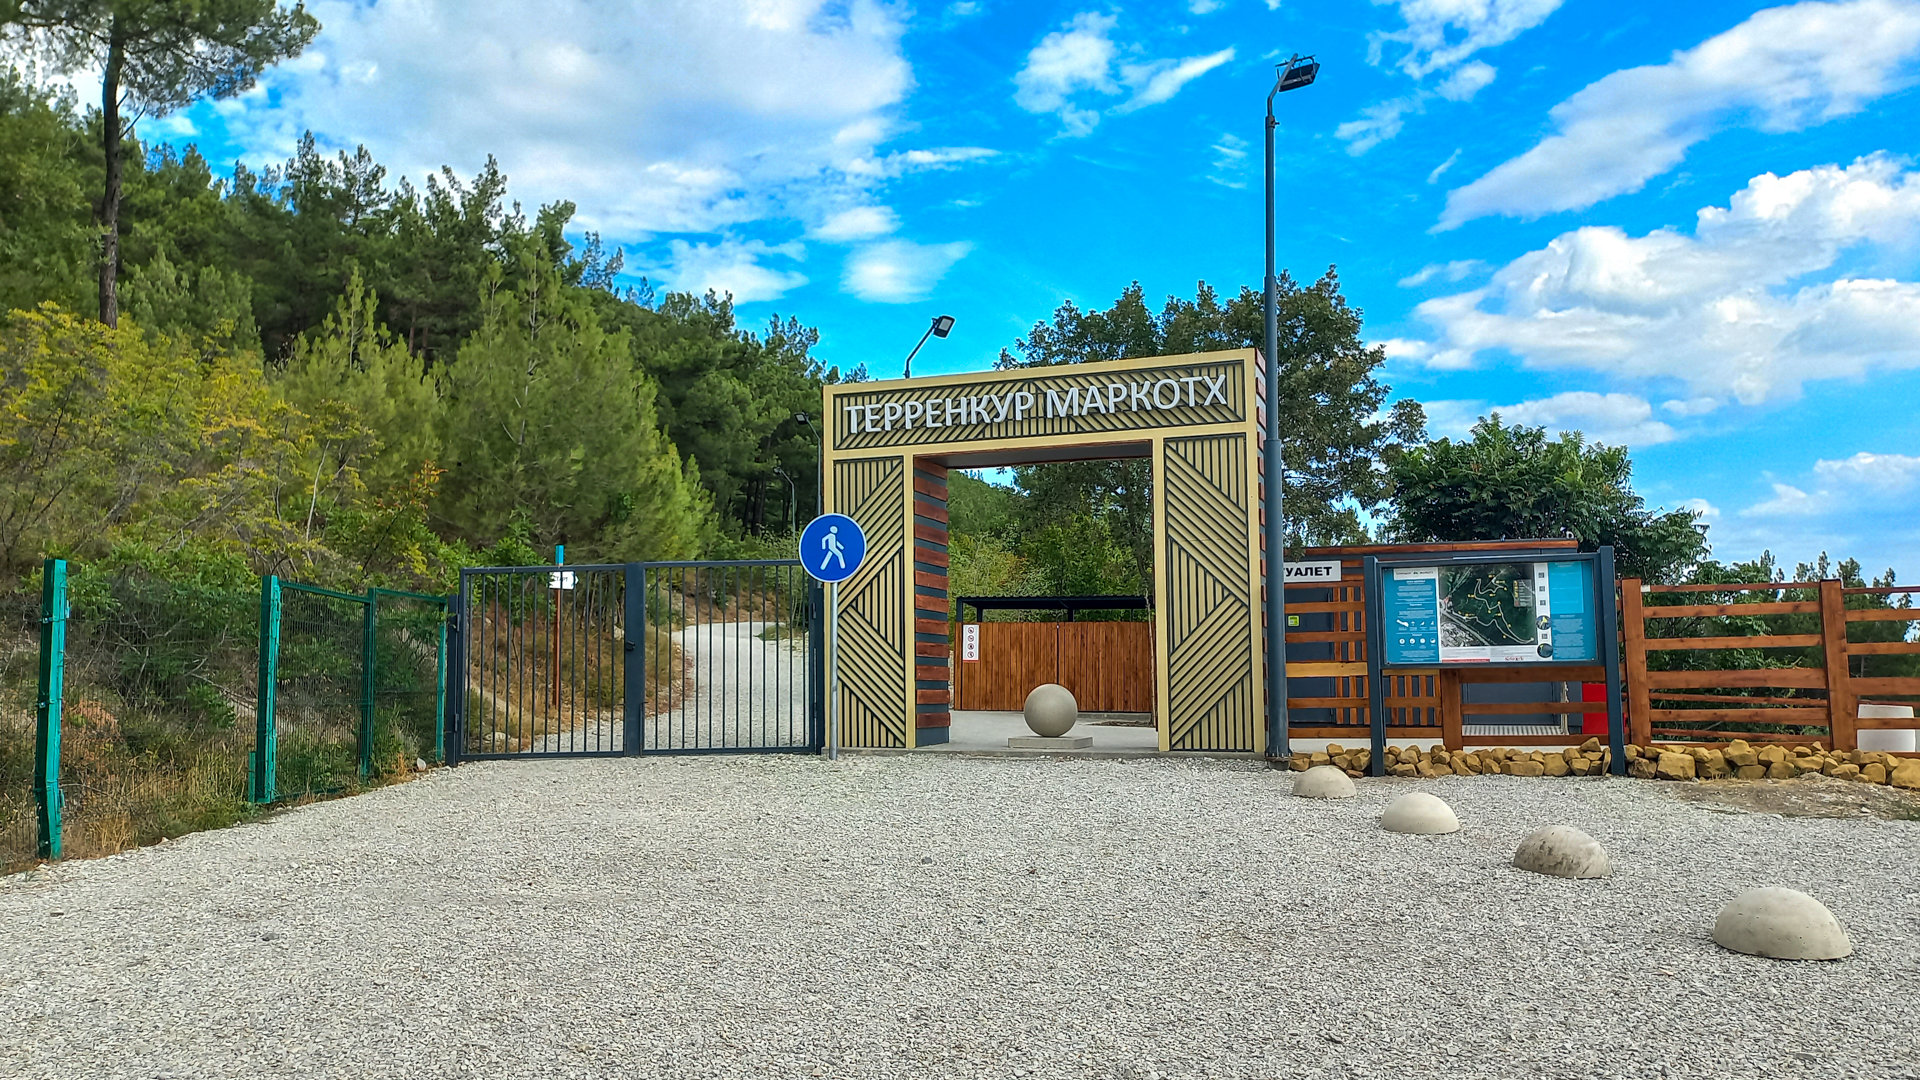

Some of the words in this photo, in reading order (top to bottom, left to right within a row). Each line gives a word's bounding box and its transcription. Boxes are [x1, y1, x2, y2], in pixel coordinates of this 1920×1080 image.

[844, 391, 1034, 434] ТЕРРЕНКУР
[1046, 374, 1228, 418] МАРКОТХ
[1284, 566, 1333, 577] УАЛЕТ
